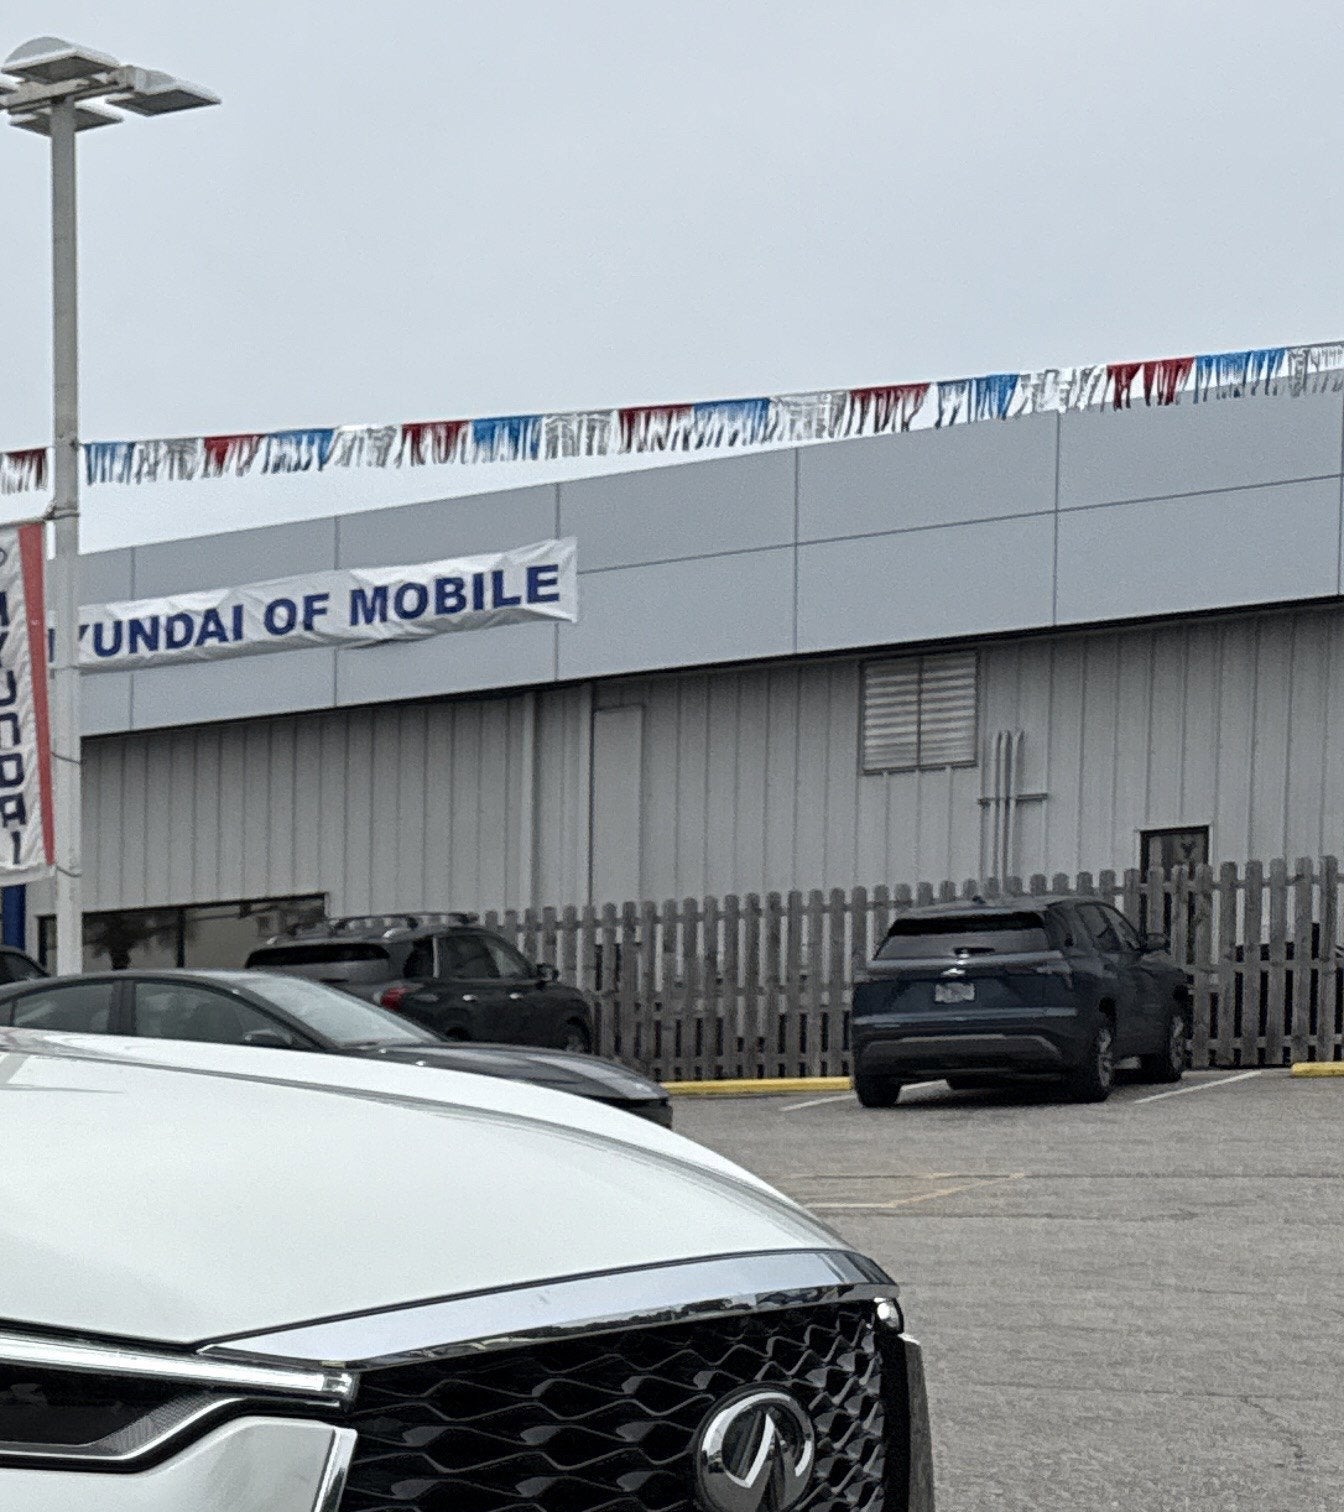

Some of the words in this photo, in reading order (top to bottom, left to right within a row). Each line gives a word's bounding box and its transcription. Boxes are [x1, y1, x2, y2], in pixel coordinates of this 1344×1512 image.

[48, 604, 244, 662] UNDAI
[263, 593, 329, 635] OF
[349, 564, 560, 626] MOBILE
